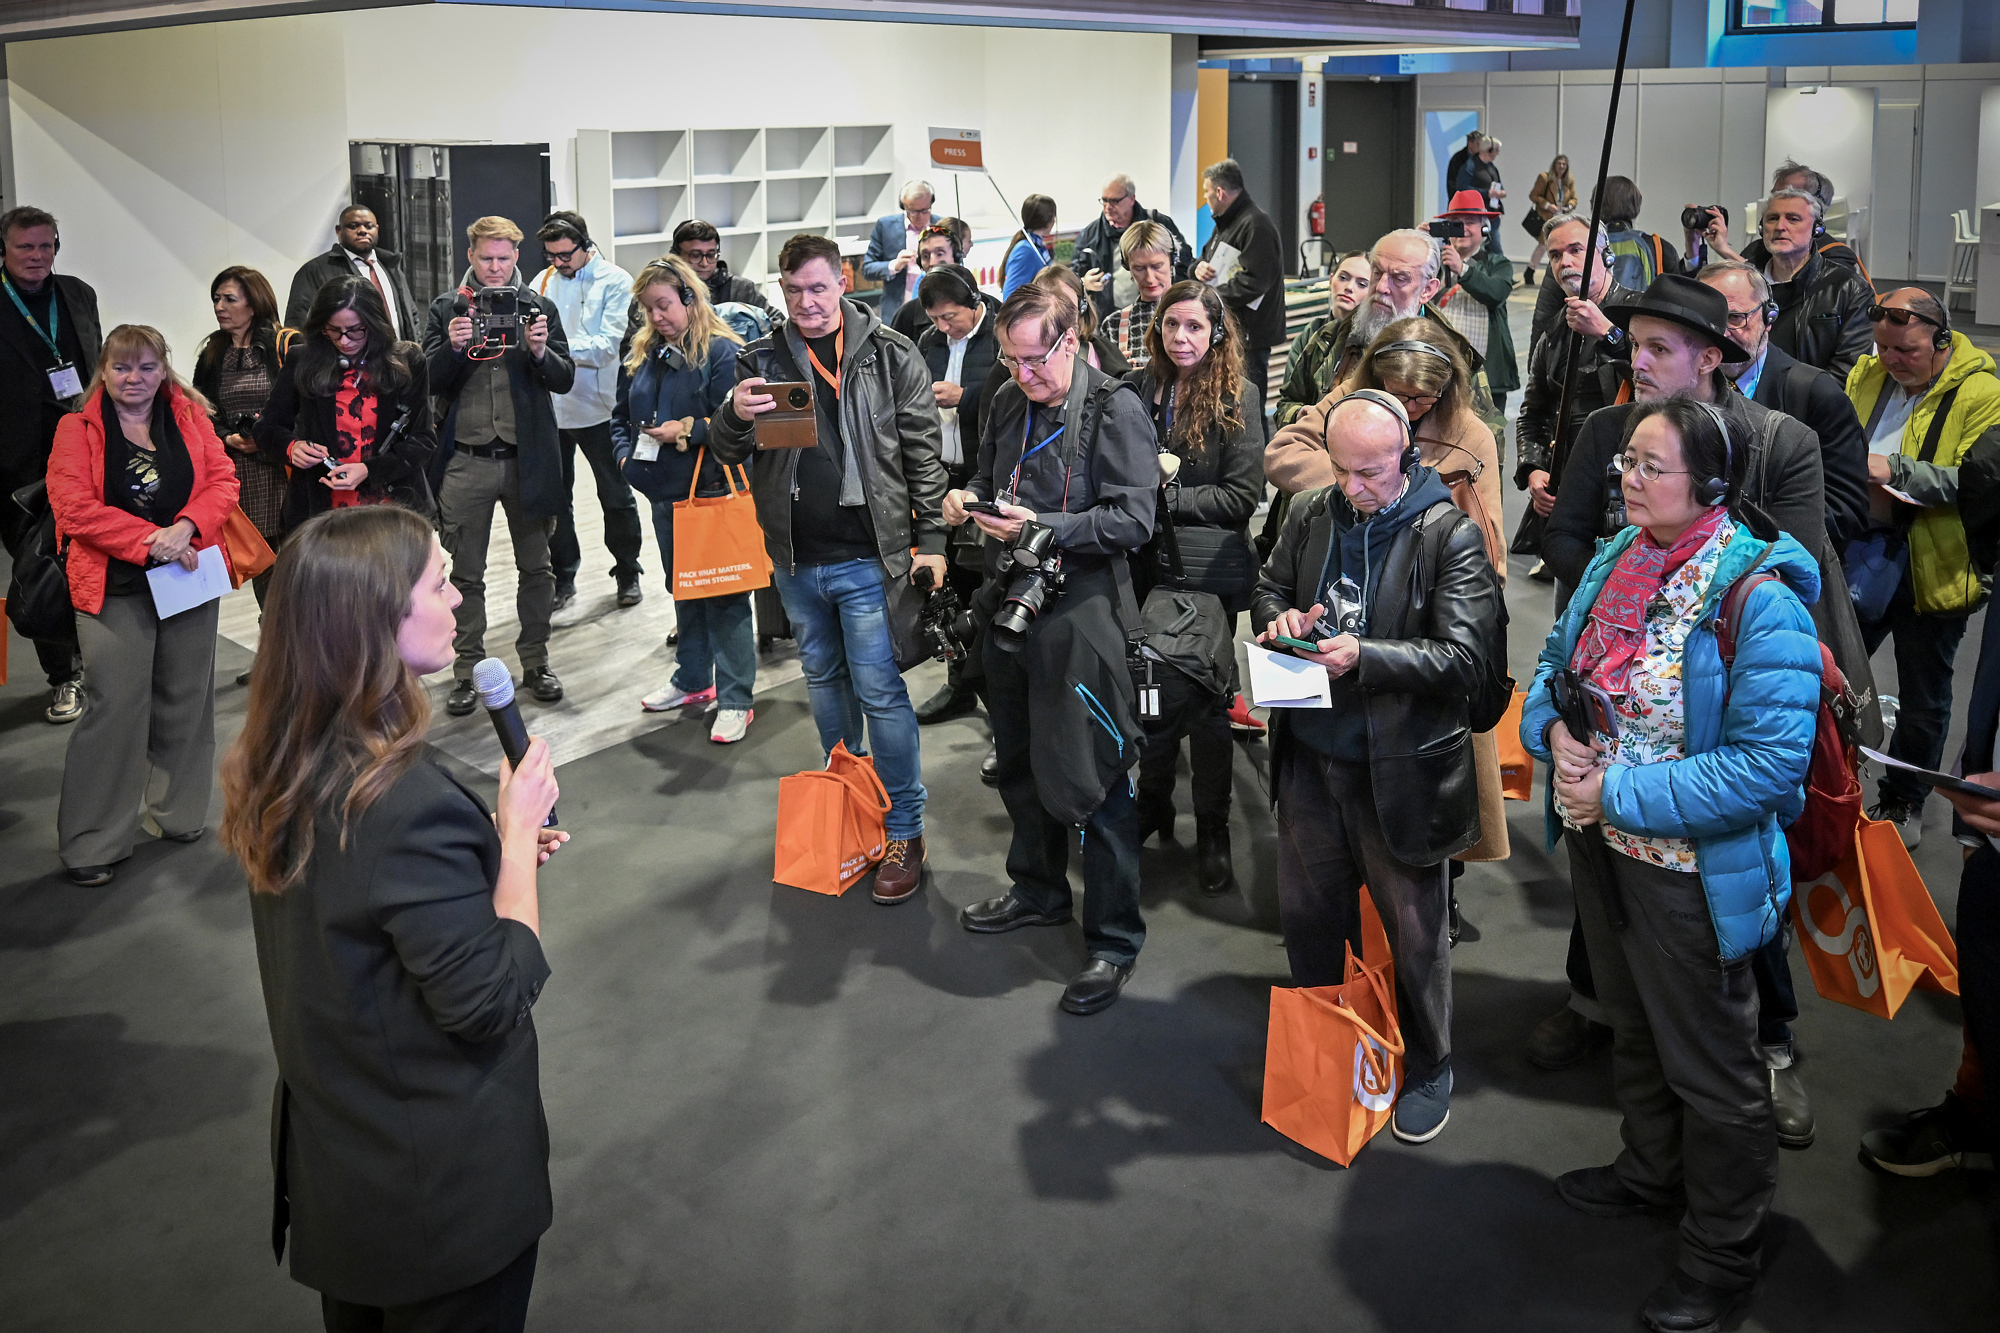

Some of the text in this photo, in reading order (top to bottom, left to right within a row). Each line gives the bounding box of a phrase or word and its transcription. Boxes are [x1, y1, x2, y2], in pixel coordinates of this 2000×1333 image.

[944, 147, 967, 157] PRESS
[678, 562, 753, 579] PACK WHAT MATTERS.
[678, 573, 743, 588] FILL WITH STORIES.
[841, 857, 858, 870] PACK
[840, 870, 853, 881] FILL
